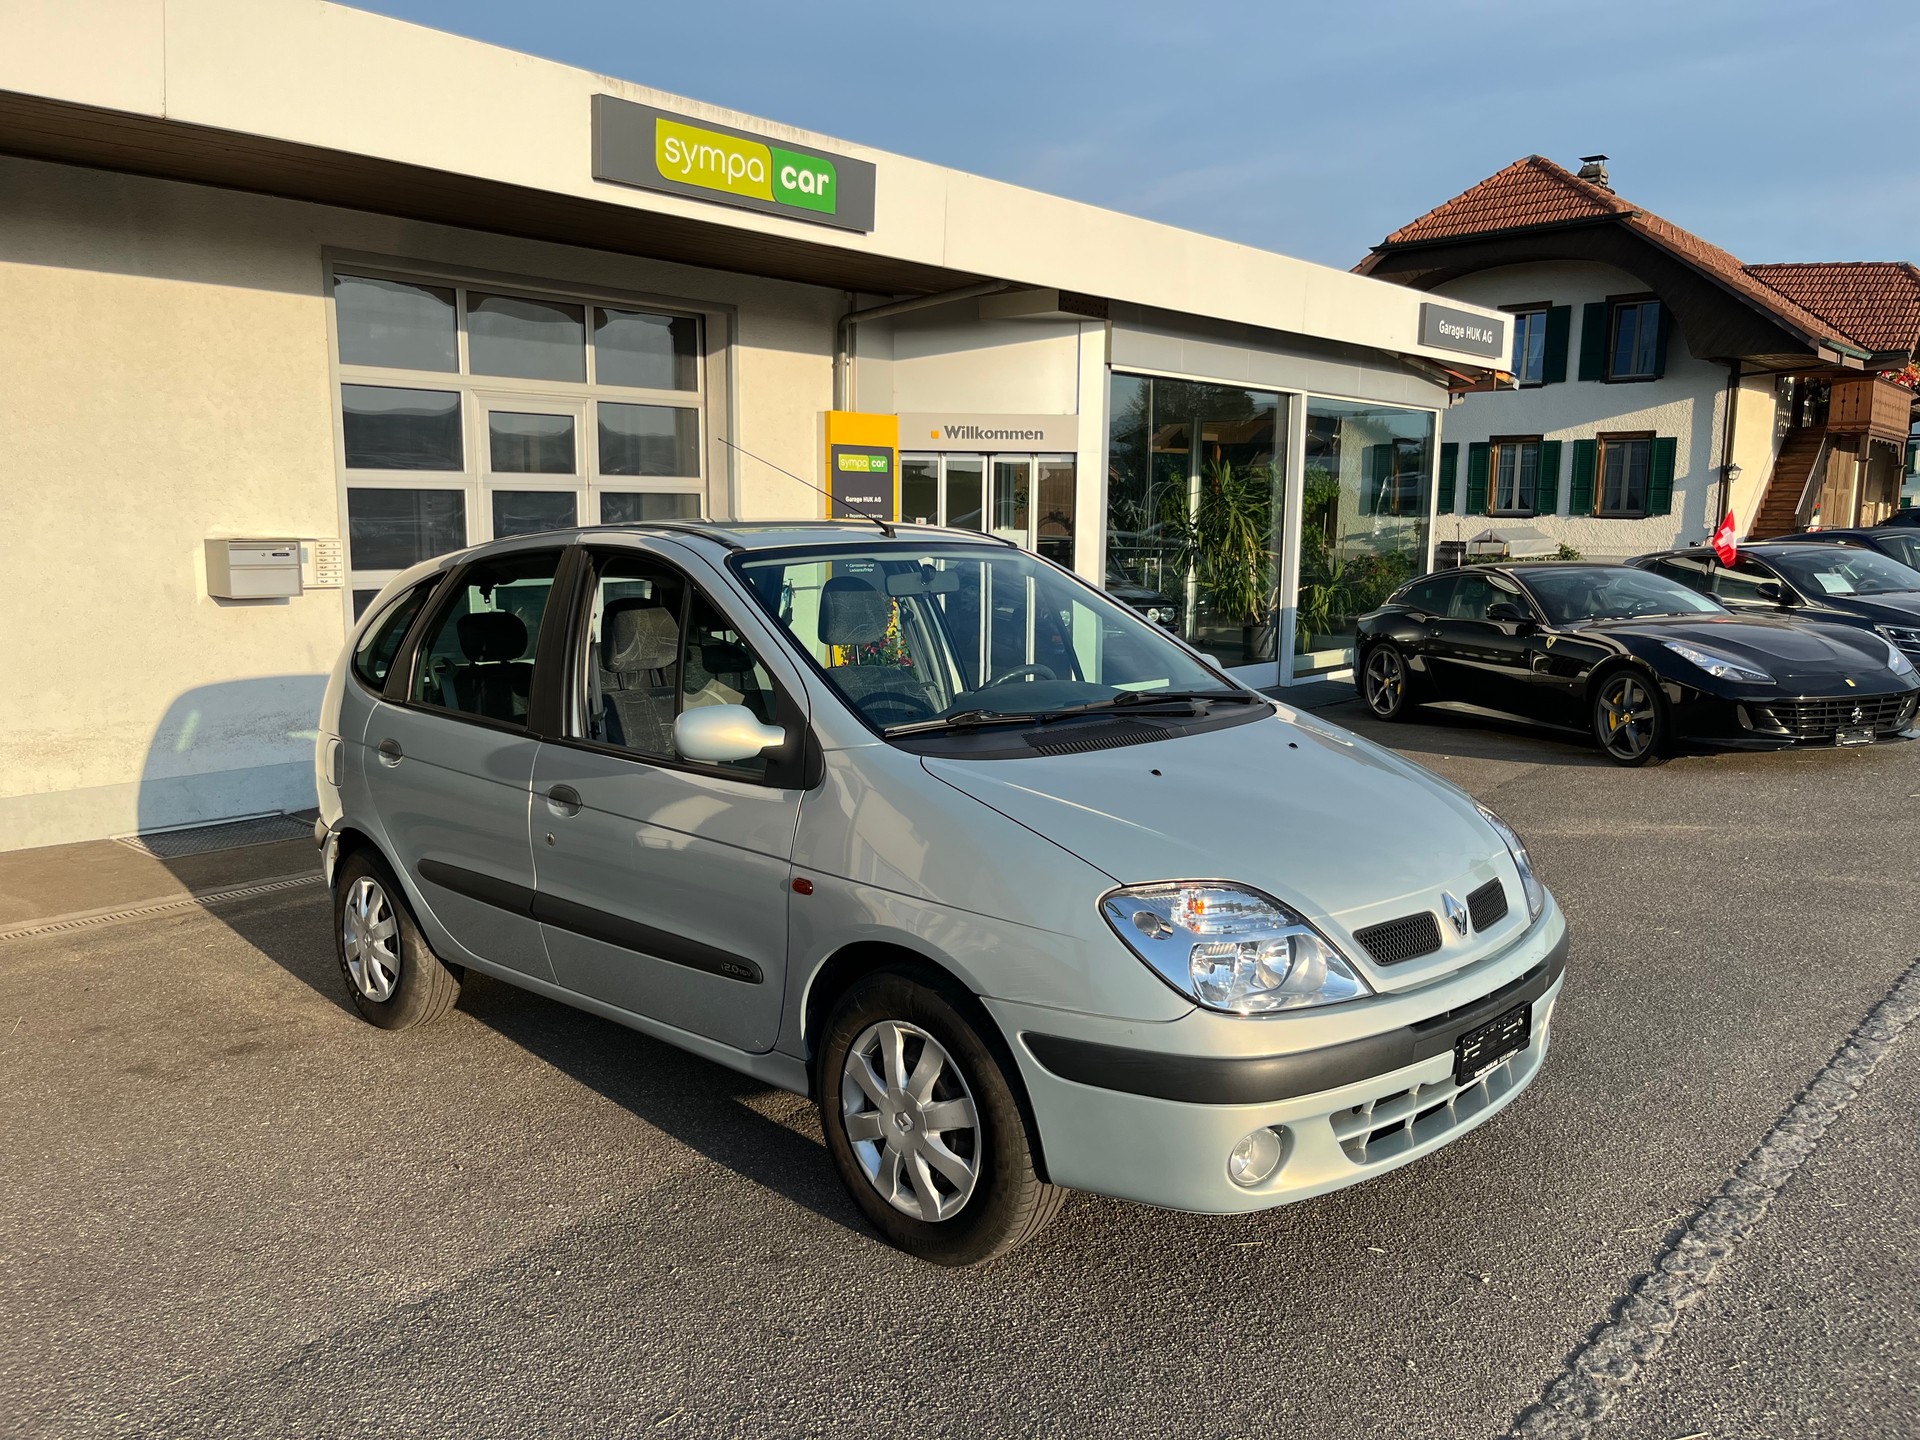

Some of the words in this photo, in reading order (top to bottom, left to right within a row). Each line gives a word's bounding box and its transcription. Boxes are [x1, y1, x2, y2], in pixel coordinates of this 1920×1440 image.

[664, 136, 765, 185] sympa
[780, 165, 830, 196] car
[1439, 320, 1465, 339] Garage
[1466, 325, 1482, 342] HUK
[1482, 330, 1493, 344] AG
[943, 425, 1044, 441] Willkommen
[840, 458, 868, 470] sympa
[871, 459, 886, 468] car
[845, 496, 863, 504] Garage
